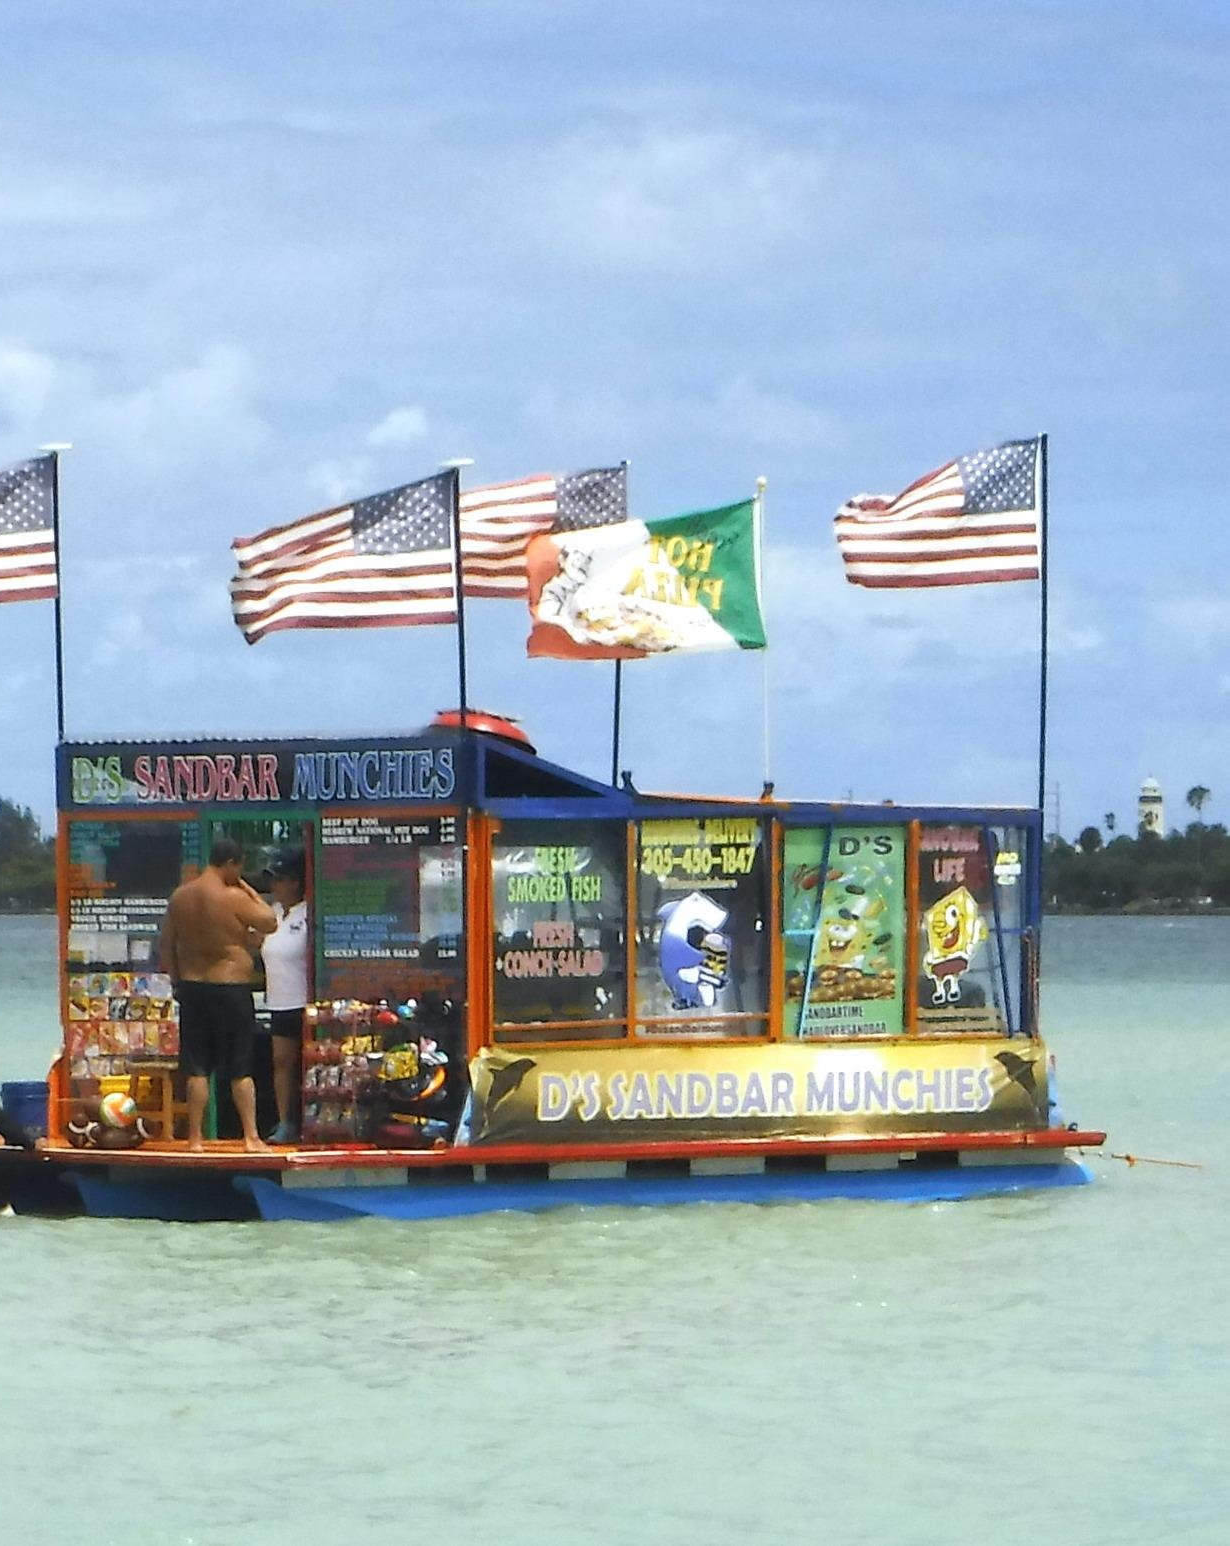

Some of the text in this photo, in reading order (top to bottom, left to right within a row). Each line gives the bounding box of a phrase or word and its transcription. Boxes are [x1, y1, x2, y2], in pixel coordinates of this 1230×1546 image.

[72, 748, 456, 803] D'S SANDBAR MUNCHIES
[839, 835, 892, 855] D'S
[641, 846, 755, 875] 305-450-1847
[508, 876, 602, 902] SMOKED FISH
[504, 950, 553, 977] CONCH
[538, 1065, 994, 1121] D'S SANDBAR MUNCHIES
